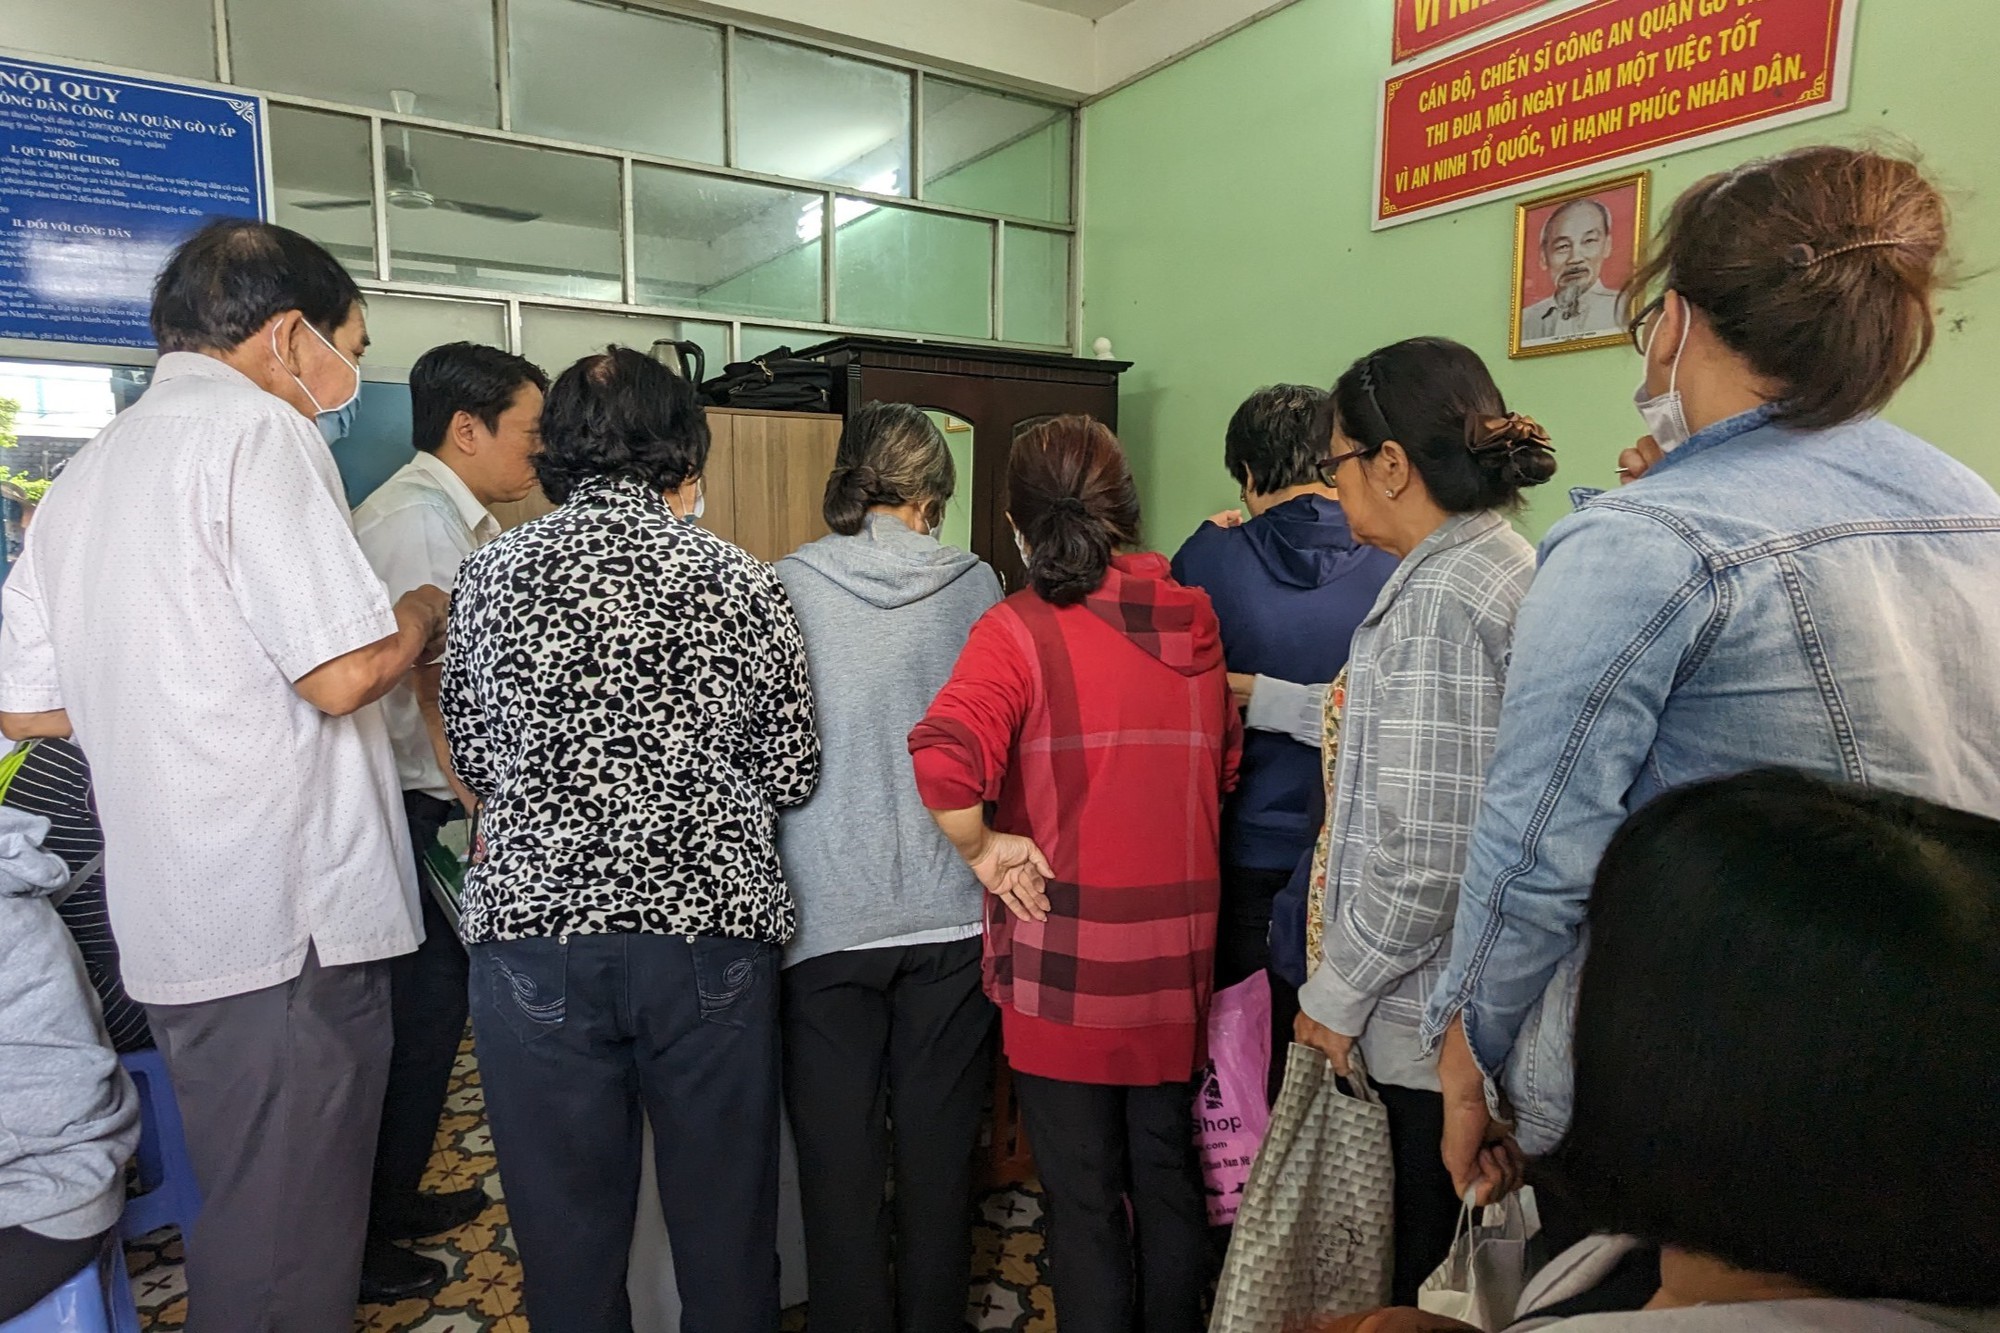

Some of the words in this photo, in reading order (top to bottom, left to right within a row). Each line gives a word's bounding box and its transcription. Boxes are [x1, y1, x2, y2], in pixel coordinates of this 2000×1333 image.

[0, 71, 53, 94] NỘI
[59, 81, 122, 104] QUY
[1418, 81, 1447, 113] CÁN
[1451, 70, 1476, 102] BỘ,
[1480, 48, 1529, 91] CHIẾN
[1533, 40, 1553, 73] SĨ
[1555, 28, 1603, 66] CÔNG
[1607, 17, 1633, 48] AN
[1426, 121, 1449, 147] THI
[1452, 110, 1482, 139] ĐUA
[1486, 89, 1517, 128] MỖI
[1521, 80, 1567, 117] NGÀY
[1572, 67, 1612, 102] LÀM
[1616, 50, 1659, 88] MỘT
[1665, 33, 1712, 72] VIỆC
[1718, 12, 1762, 56] TỐT
[0, 91, 33, 107] ÔNG
[36, 98, 68, 112] DÂN
[71, 103, 114, 119] CÔNG
[118, 112, 138, 122] AN
[141, 115, 182, 130] QUẬN
[184, 120, 206, 133] GÒ
[208, 122, 236, 137] VẤP
[1395, 166, 1409, 193] VÌ
[1410, 164, 1430, 189] AN
[1433, 152, 1467, 183] NINH
[1471, 133, 1493, 171] TỔ
[1496, 124, 1544, 167] QUỐC,
[1550, 117, 1567, 149] VÌ
[1572, 106, 1622, 144] HẠNH
[1628, 86, 1681, 127] PHÚC
[1686, 69, 1746, 111] NHÂN
[1752, 52, 1806, 93] DÂN.
[21, 146, 46, 157] QUY
[79, 154, 120, 167] CHUNG
[73, 224, 106, 236] CÔNG
[108, 227, 131, 238] DÂN
